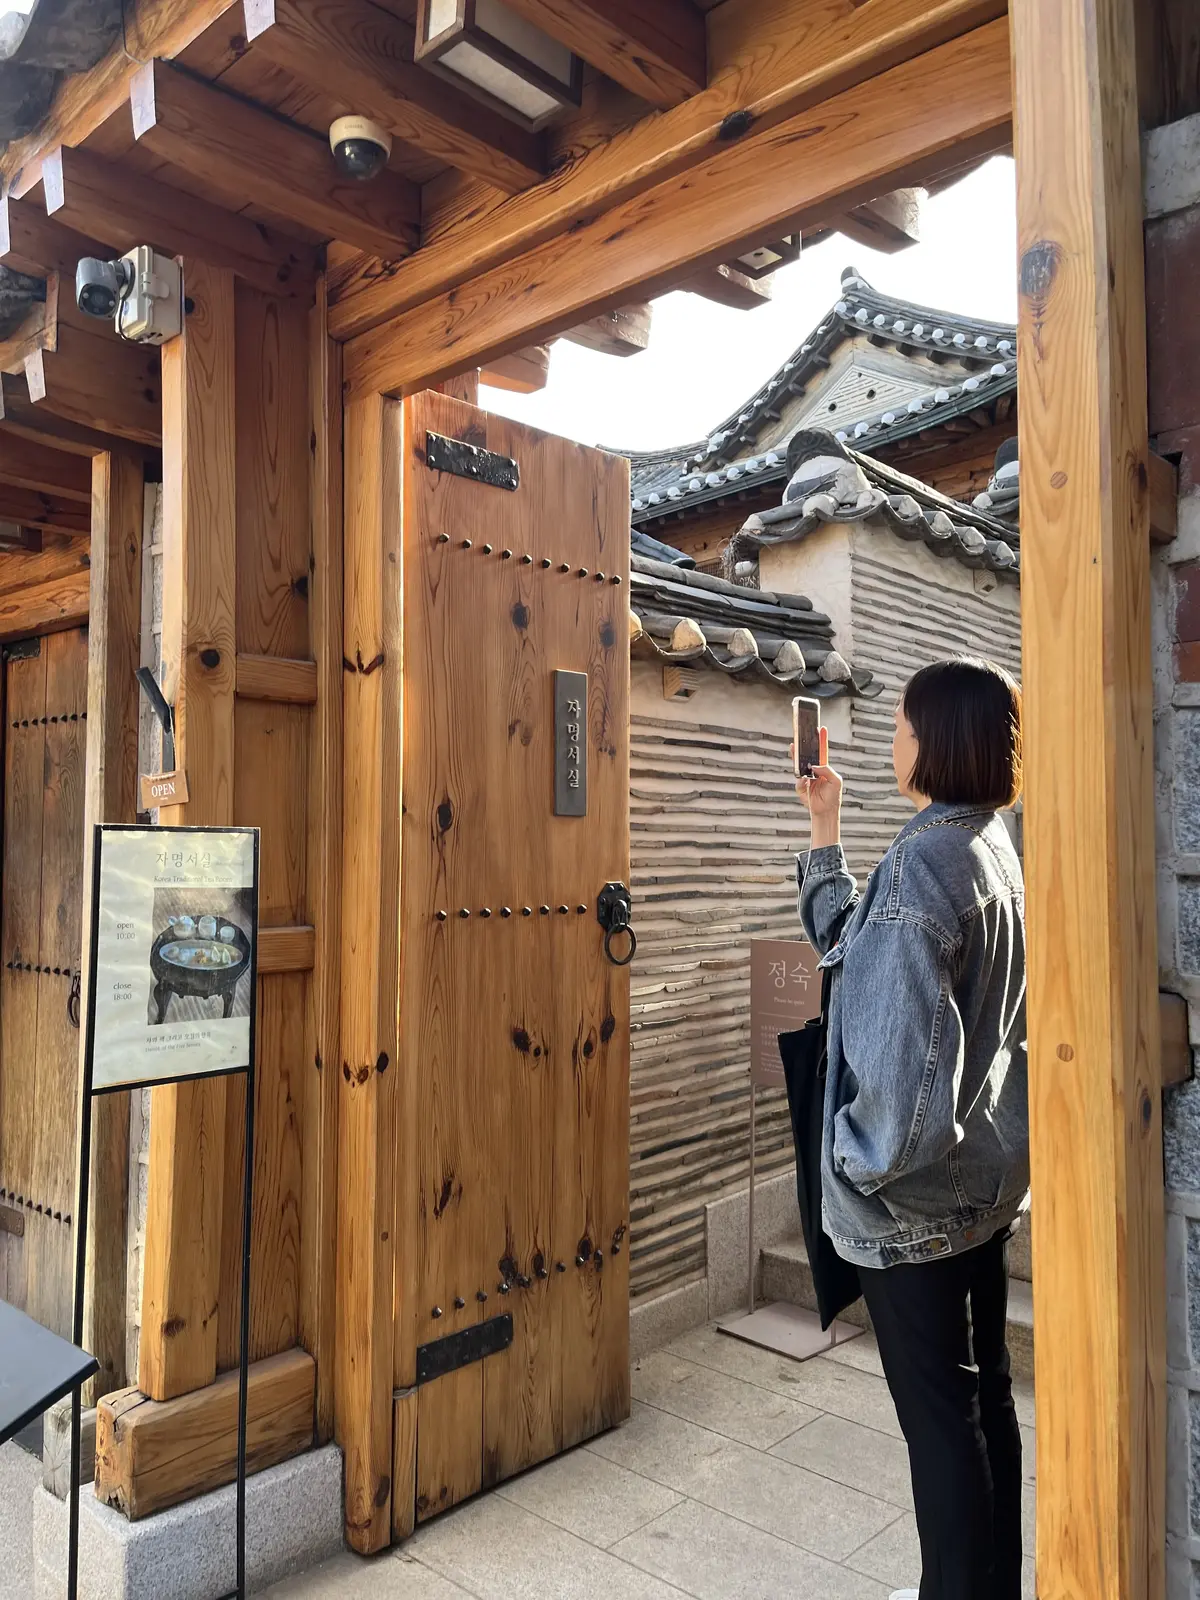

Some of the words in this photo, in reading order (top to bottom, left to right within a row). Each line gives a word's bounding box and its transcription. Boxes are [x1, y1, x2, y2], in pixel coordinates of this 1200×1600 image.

[566, 699, 582, 788] 자명서실
[151, 781, 176, 798] OPEN
[155, 851, 211, 868] 자명서실
[215, 875, 233, 883] Room
[116, 922, 135, 930] open
[116, 932, 136, 940] 10:00
[767, 959, 812, 992] 정숙
[113, 982, 132, 990] close
[113, 993, 132, 1001] 18:00
